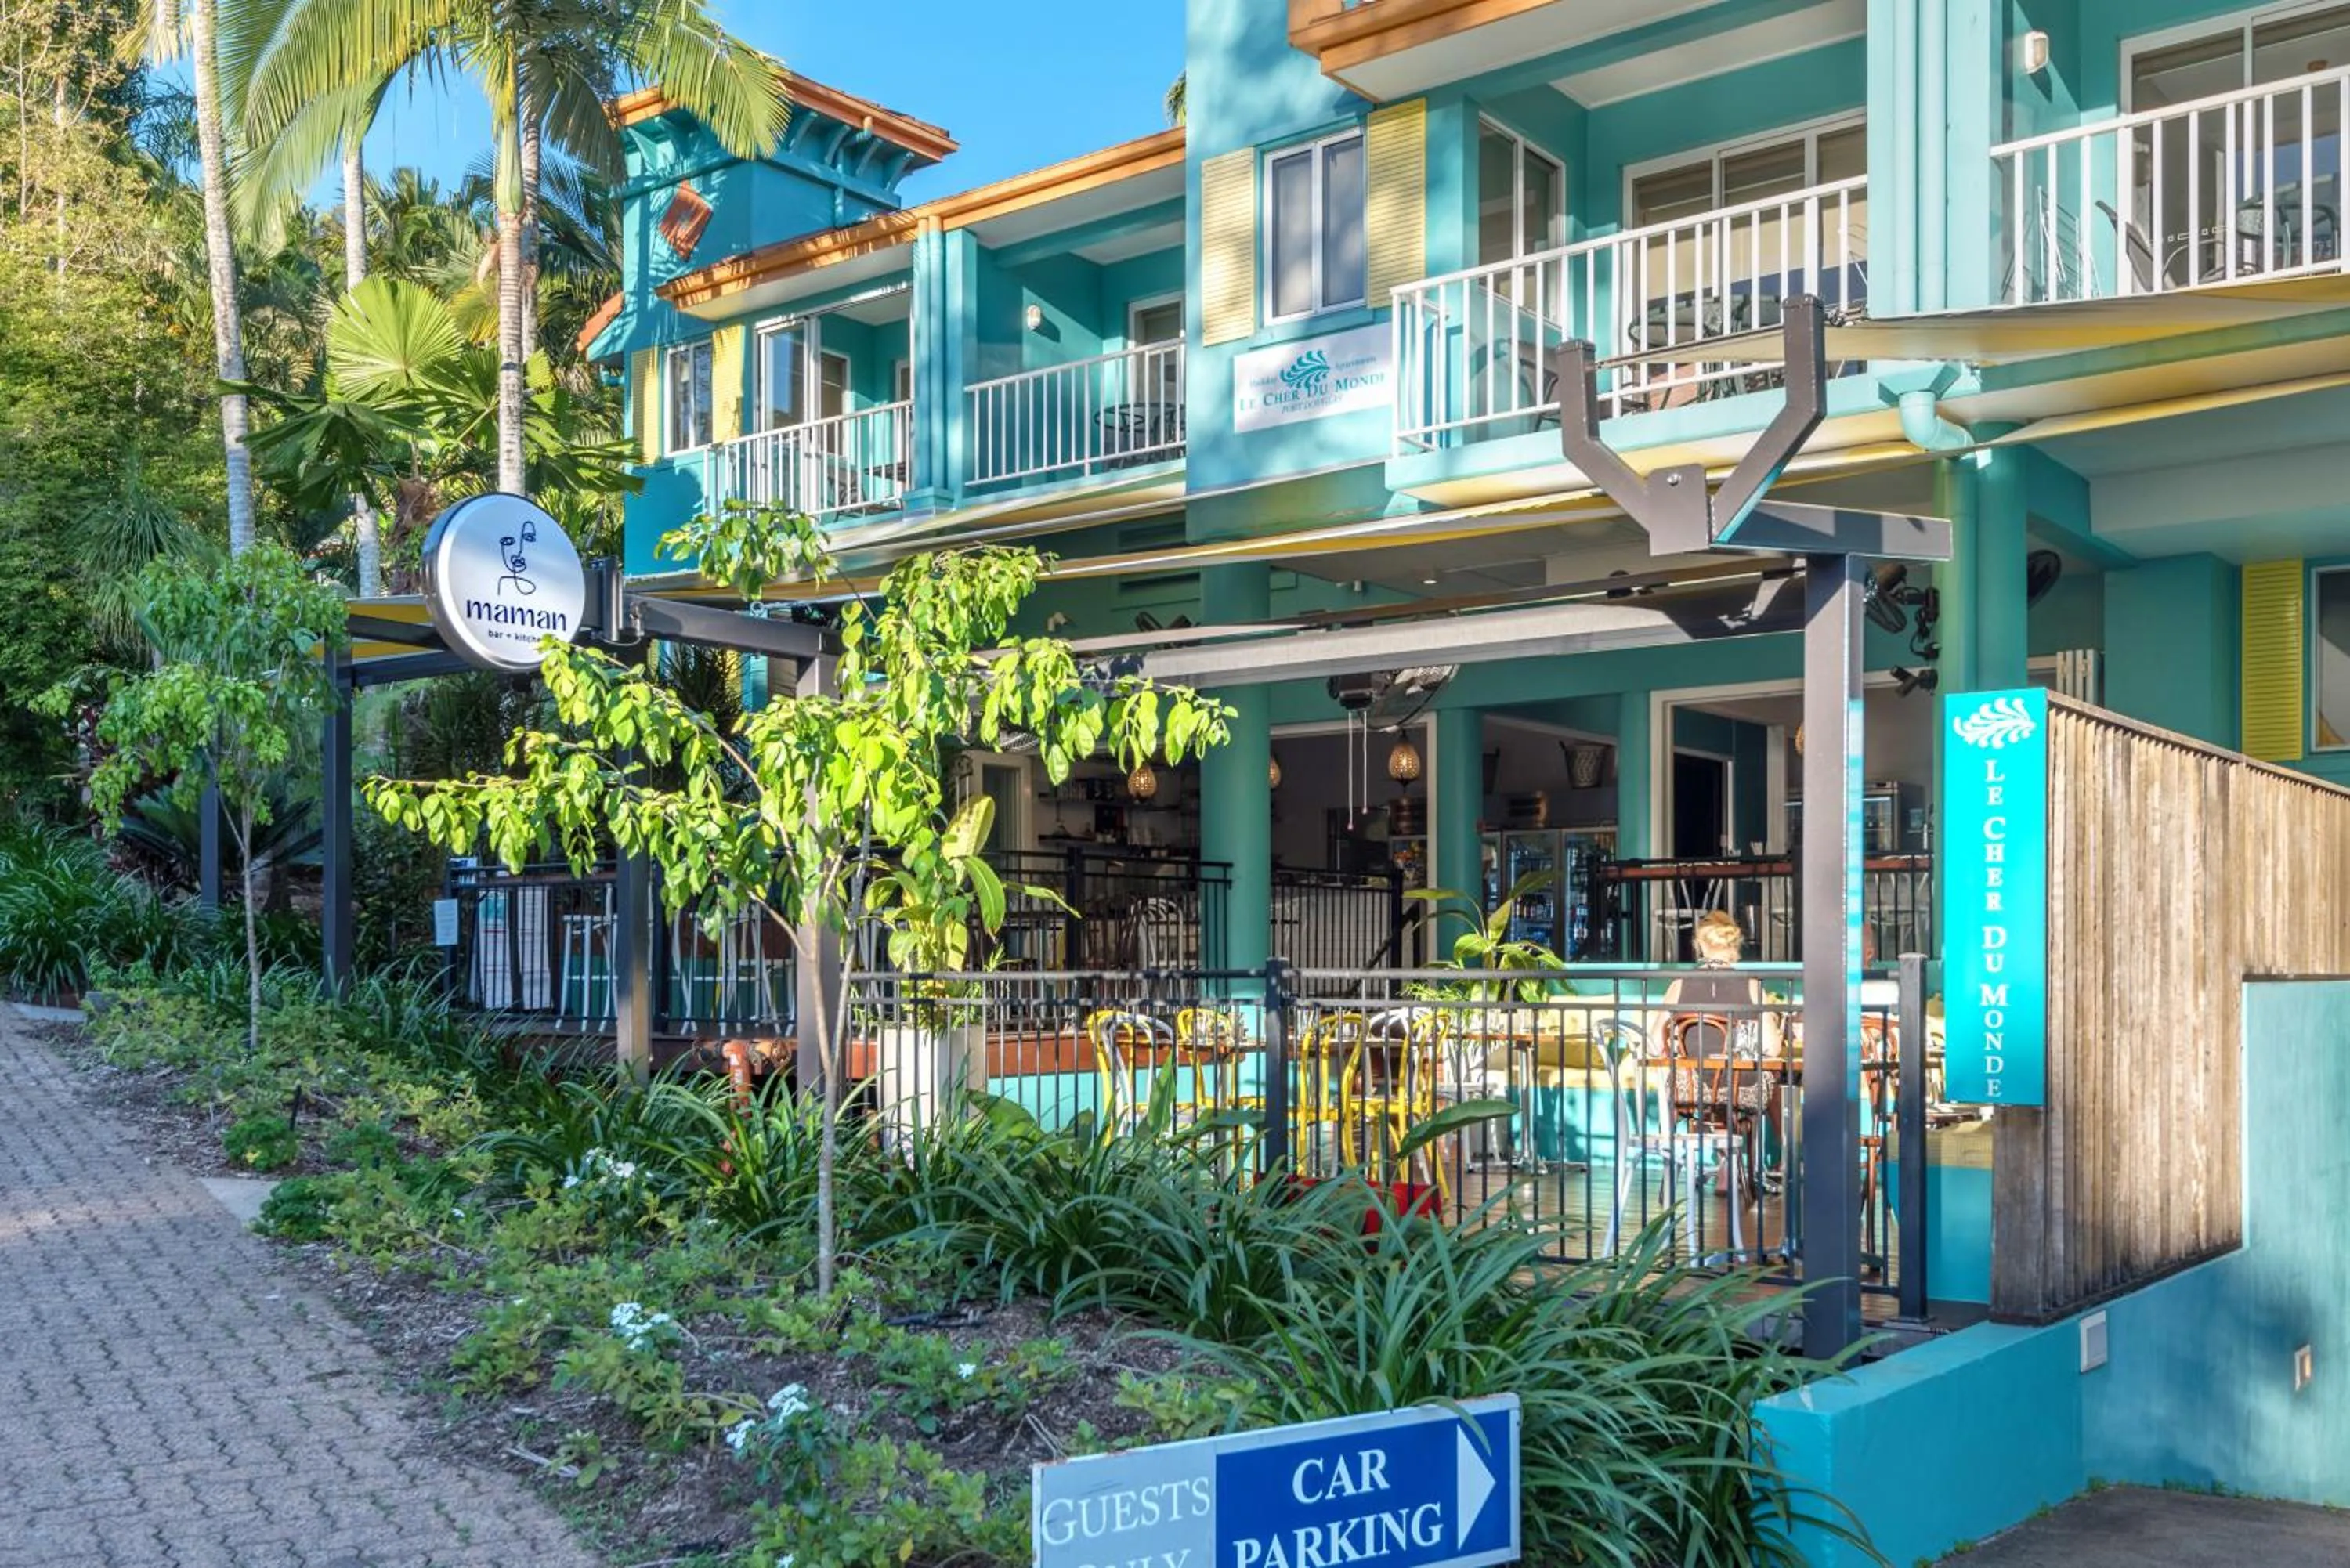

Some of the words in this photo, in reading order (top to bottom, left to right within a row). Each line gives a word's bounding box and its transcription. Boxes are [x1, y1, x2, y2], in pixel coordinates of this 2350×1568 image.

[1263, 389, 1300, 407] CHER
[1307, 382, 1329, 398] DU
[466, 599, 566, 631] maman
[488, 628, 503, 638] bar
[515, 632, 543, 643] kitche
[1984, 759, 2005, 806] LE
[1983, 815, 2007, 912] CHER
[1981, 925, 2007, 974] DU
[1979, 982, 2010, 1098] MONDE
[1292, 1448, 1391, 1504] CAR
[1041, 1476, 1211, 1545] GUESTS
[1232, 1501, 1444, 1568] PARKING
